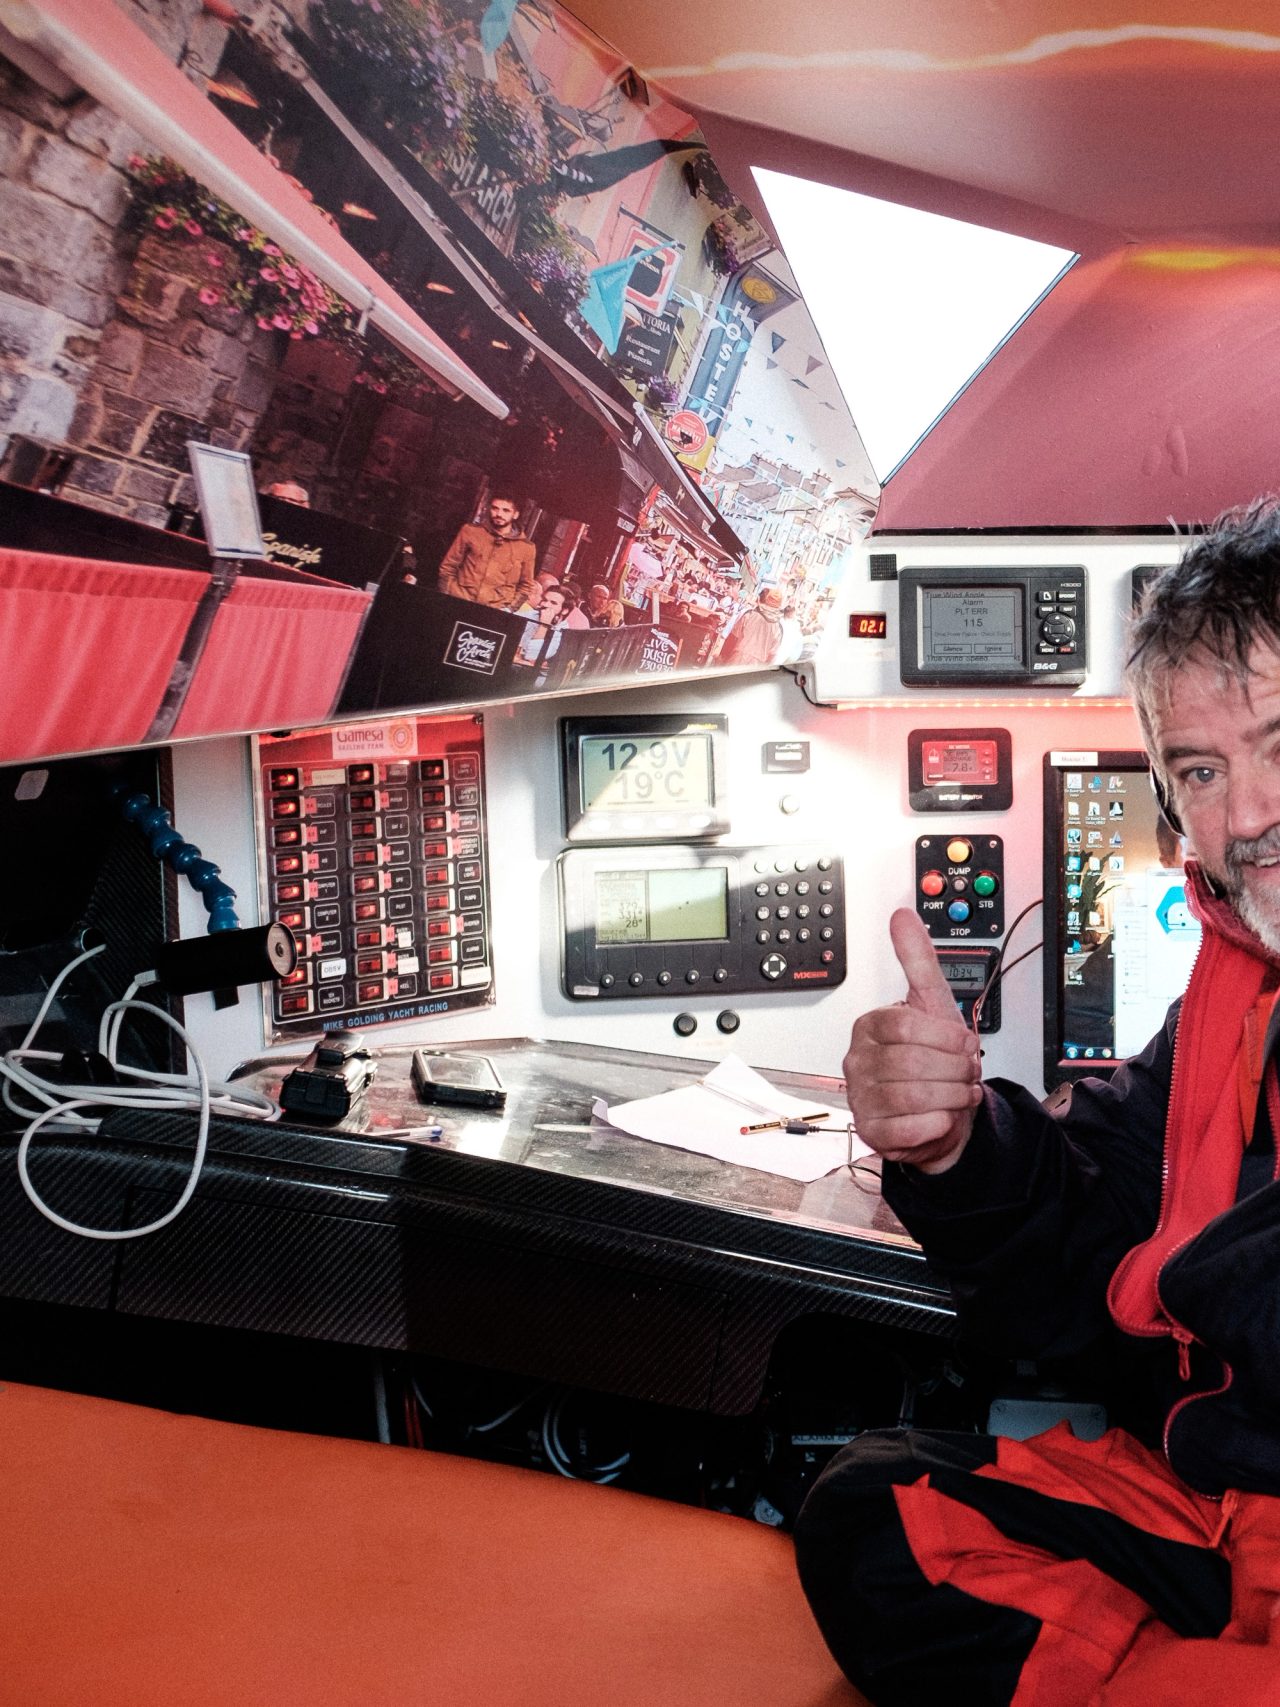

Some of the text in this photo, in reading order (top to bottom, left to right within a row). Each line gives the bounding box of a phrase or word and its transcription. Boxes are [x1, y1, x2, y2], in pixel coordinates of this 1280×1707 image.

[955, 607, 988, 615] PLT ERR
[860, 619, 885, 634] 02.1
[964, 618, 983, 627] 115
[336, 729, 384, 743] Gamesa
[948, 867, 971, 875] DUMP
[923, 900, 994, 910] PORT STB
[950, 928, 971, 936] STOP
[323, 1001, 449, 1031] MIKE GOLDING YACHT RACING
